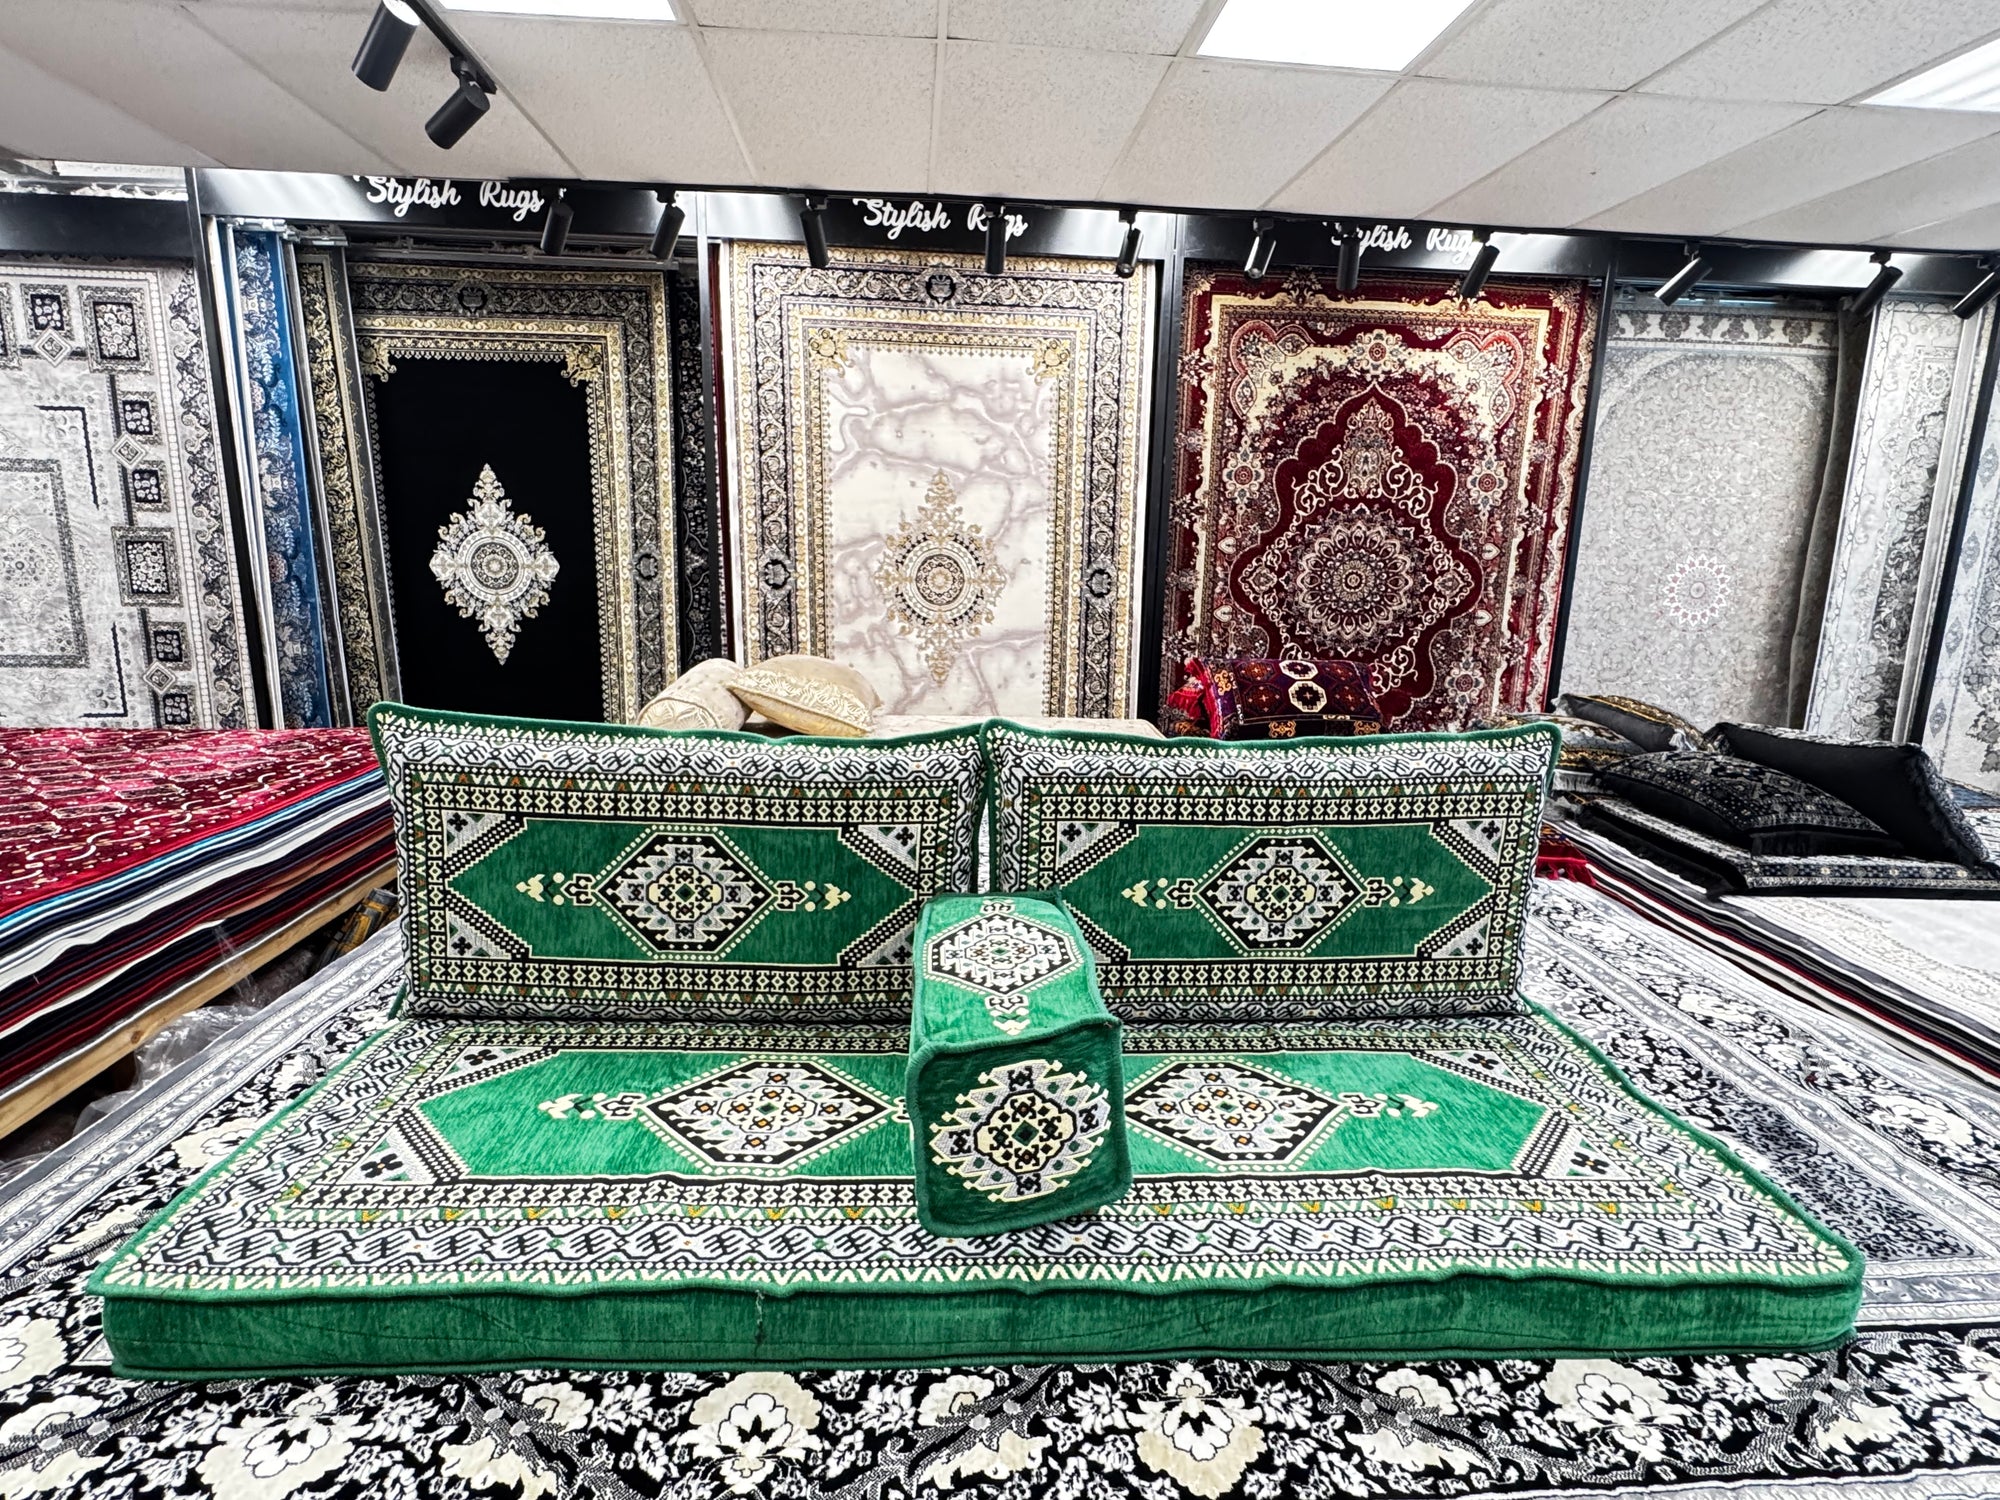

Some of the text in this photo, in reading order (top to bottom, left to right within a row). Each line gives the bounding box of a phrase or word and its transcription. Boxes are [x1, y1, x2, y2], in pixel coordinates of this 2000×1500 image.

[353, 174, 544, 222] Stylish Rugs
[852, 198, 1028, 243] Stylish Rgs
